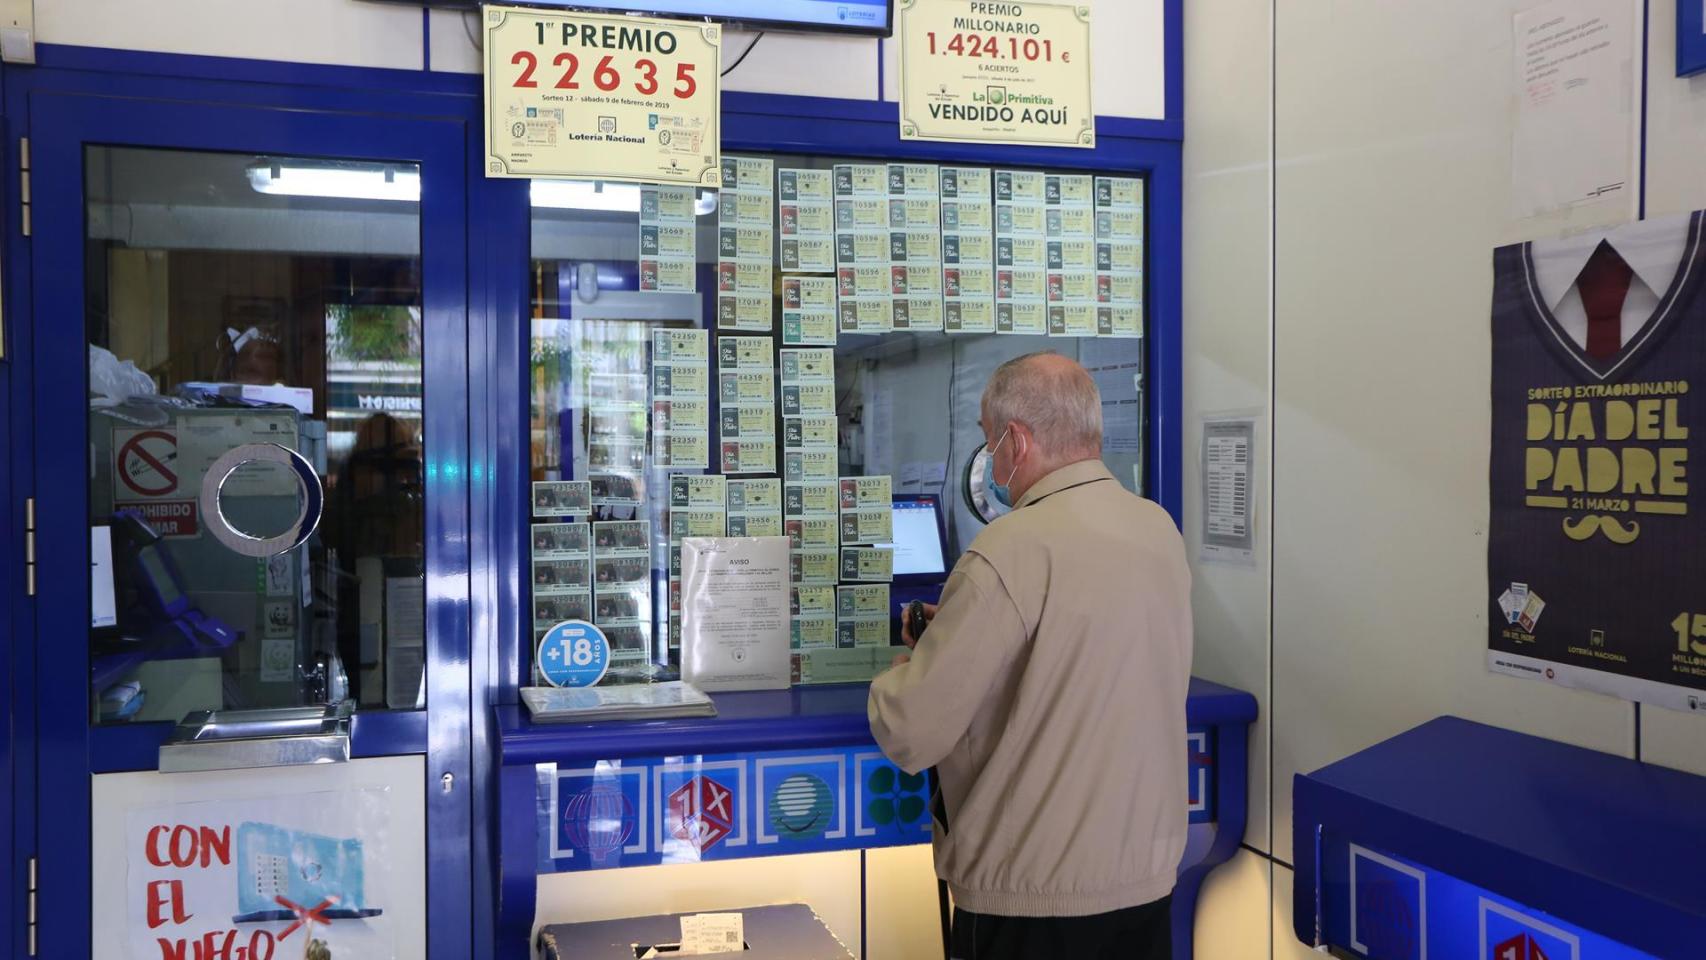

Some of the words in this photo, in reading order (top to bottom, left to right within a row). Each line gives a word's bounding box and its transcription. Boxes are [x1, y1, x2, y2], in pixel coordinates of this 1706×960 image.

[970, 2, 1022, 17] PREMIO
[953, 17, 1040, 35] MILLONARIO
[562, 22, 677, 54] PREMIO
[927, 32, 1051, 62] 1.424.101
[1062, 52, 1070, 63] €
[985, 65, 1019, 73] ACIERTOS
[542, 94, 563, 102] Sorteo
[580, 96, 604, 104] sábado
[621, 98, 644, 106] febrero
[973, 92, 985, 102] La
[1008, 94, 1053, 105] Primitiva
[929, 103, 1014, 121] VENDIDO
[1021, 106, 1067, 125] AQUÍ
[568, 133, 602, 141] Lotería
[606, 134, 645, 144] Nacional
[1528, 387, 1572, 400] SORTEO
[1574, 380, 1688, 398] EXTRAORDINARIO
[1527, 401, 1595, 440] DÍA
[1606, 399, 1688, 440] DEL
[1526, 447, 1688, 496] PADRE
[1572, 498, 1584, 509] 21
[1587, 498, 1630, 512] MARZO
[547, 639, 592, 666] +18
[145, 824, 231, 869] CON
[147, 880, 194, 928] EL
